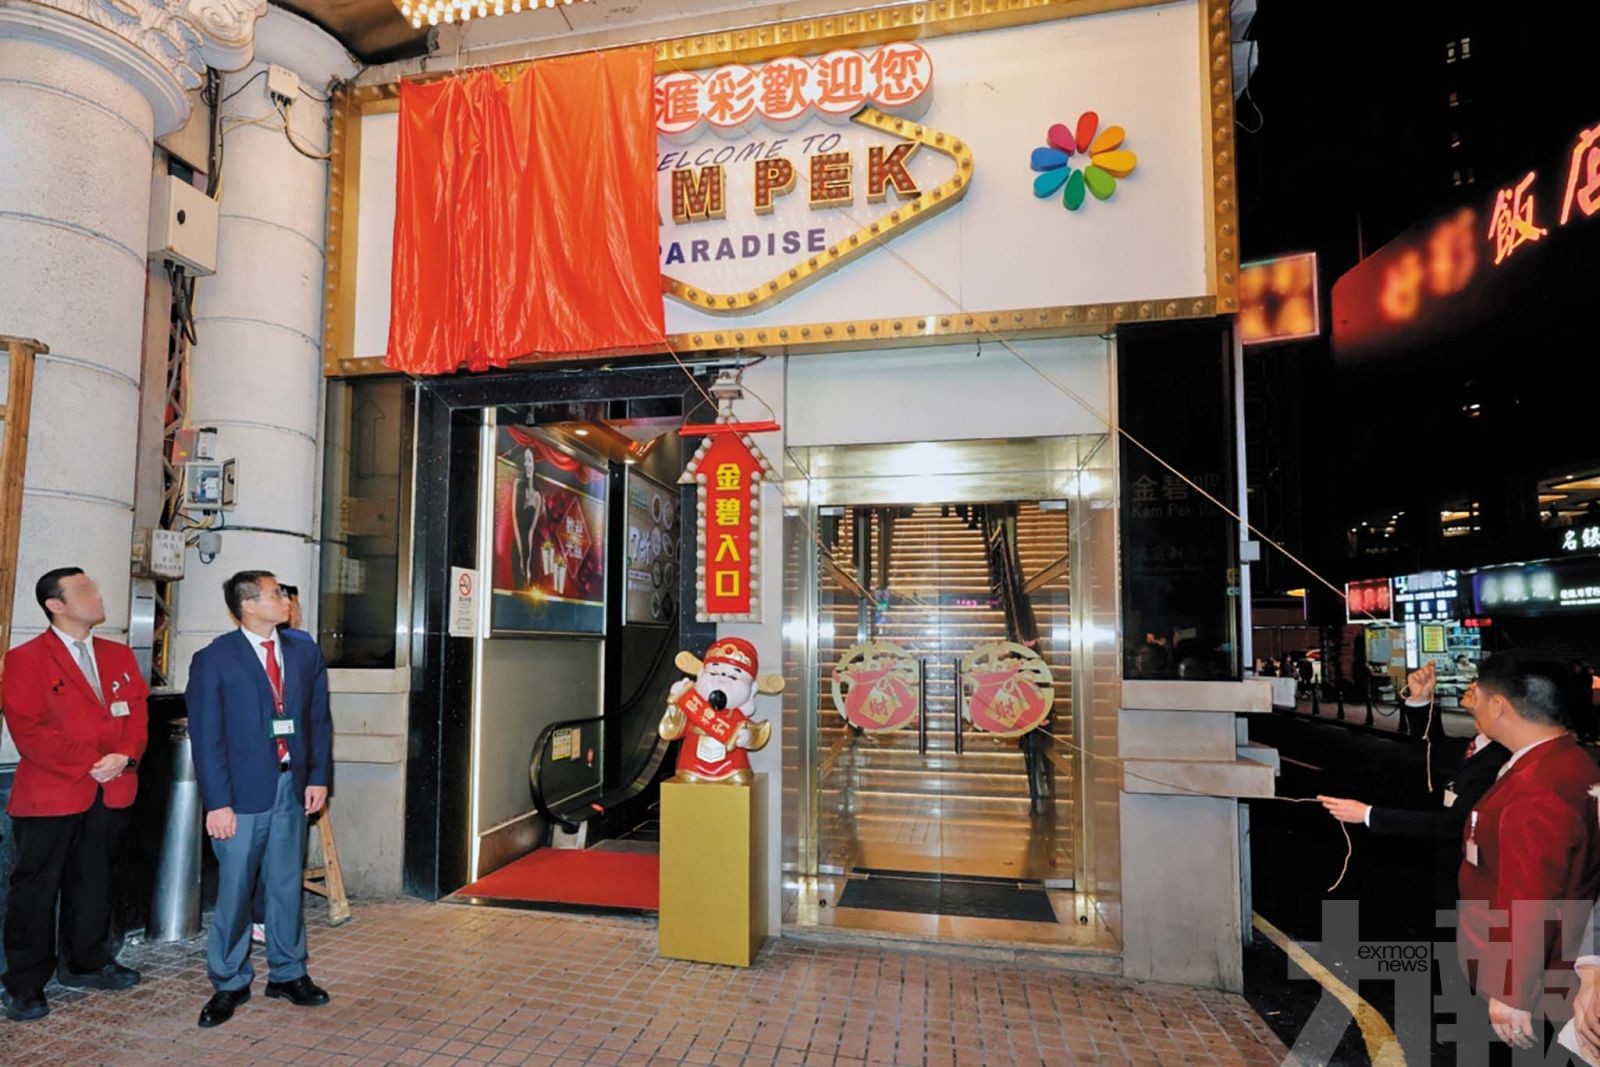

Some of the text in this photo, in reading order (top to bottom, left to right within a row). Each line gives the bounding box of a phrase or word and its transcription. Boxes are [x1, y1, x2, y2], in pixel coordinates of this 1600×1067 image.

[657, 133, 841, 172] ELCOME TO
[659, 141, 921, 225] M PEK
[659, 228, 826, 265] ARADISE
[715, 463, 742, 598] 金碧入口
